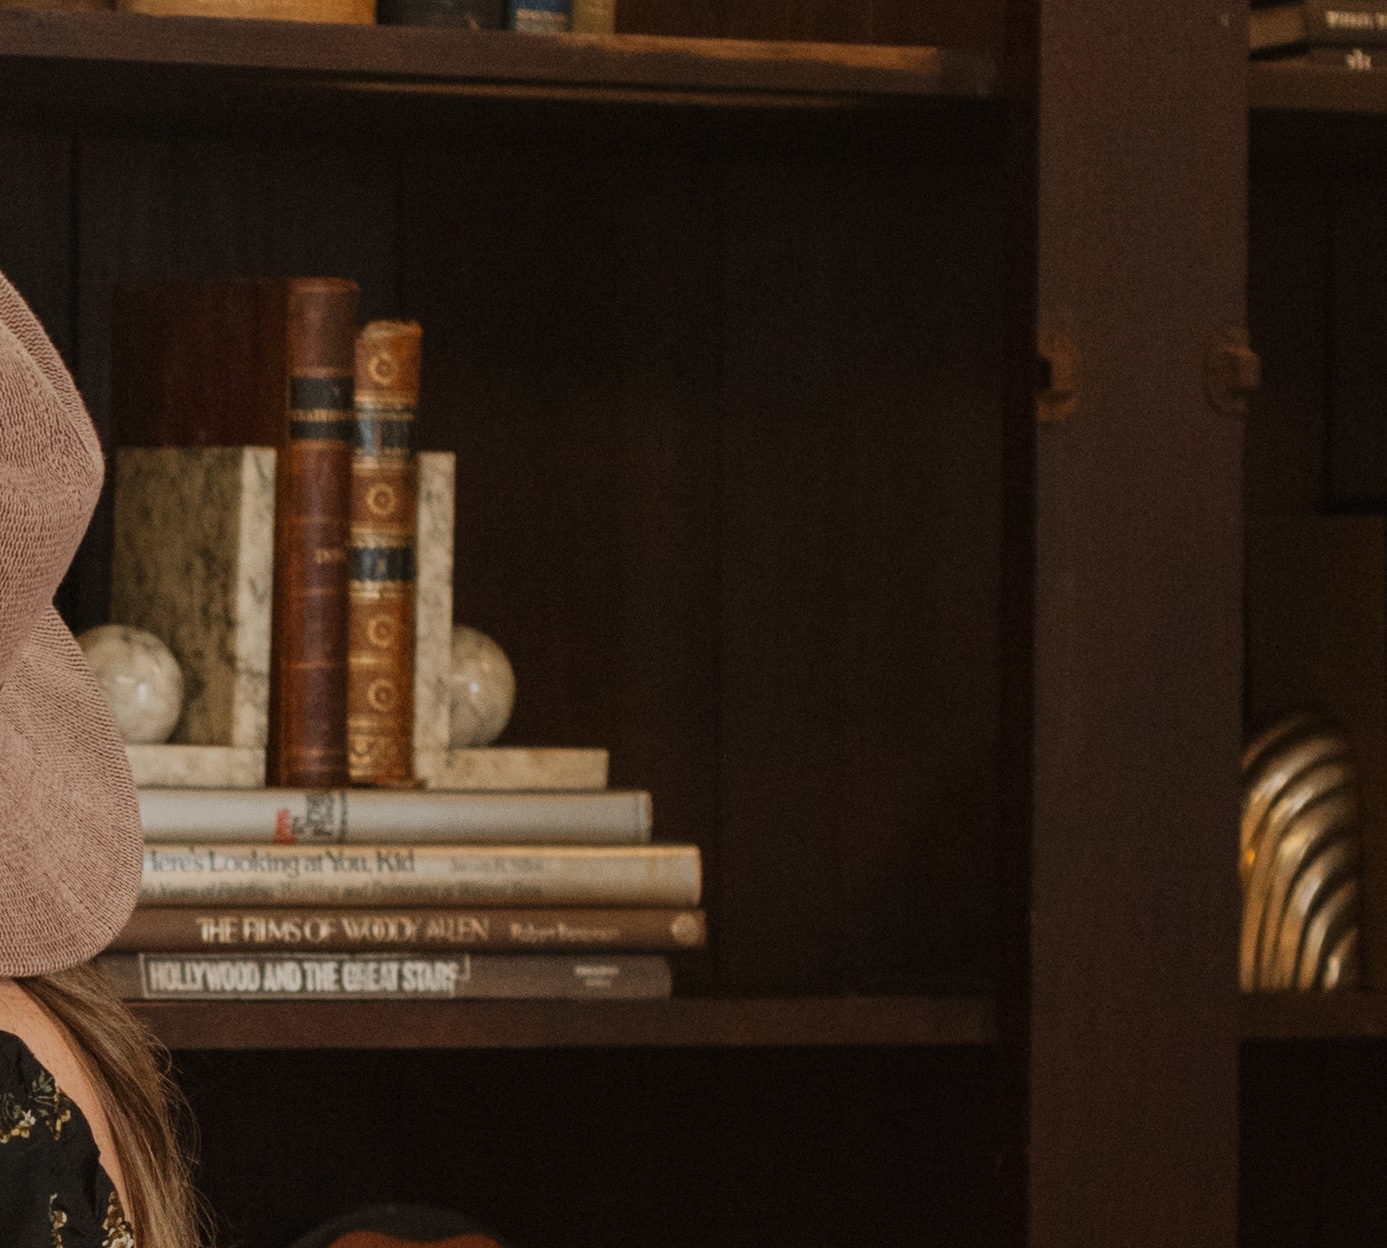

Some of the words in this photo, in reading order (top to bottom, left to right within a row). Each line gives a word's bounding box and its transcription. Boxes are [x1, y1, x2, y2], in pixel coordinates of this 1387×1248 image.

[208, 848, 301, 879] Looking
[305, 855, 323, 873] at
[376, 848, 416, 873] Kid
[196, 916, 239, 944] THE
[242, 916, 302, 944] FILMS
[303, 916, 335, 944] OF
[341, 916, 423, 944] WOODY
[427, 916, 490, 944] ALLEN
[147, 960, 262, 992] HOLLYWOOD
[263, 960, 303, 992] AND
[303, 960, 341, 992] THE
[341, 960, 401, 992] GREAT
[401, 960, 458, 992] STARS
